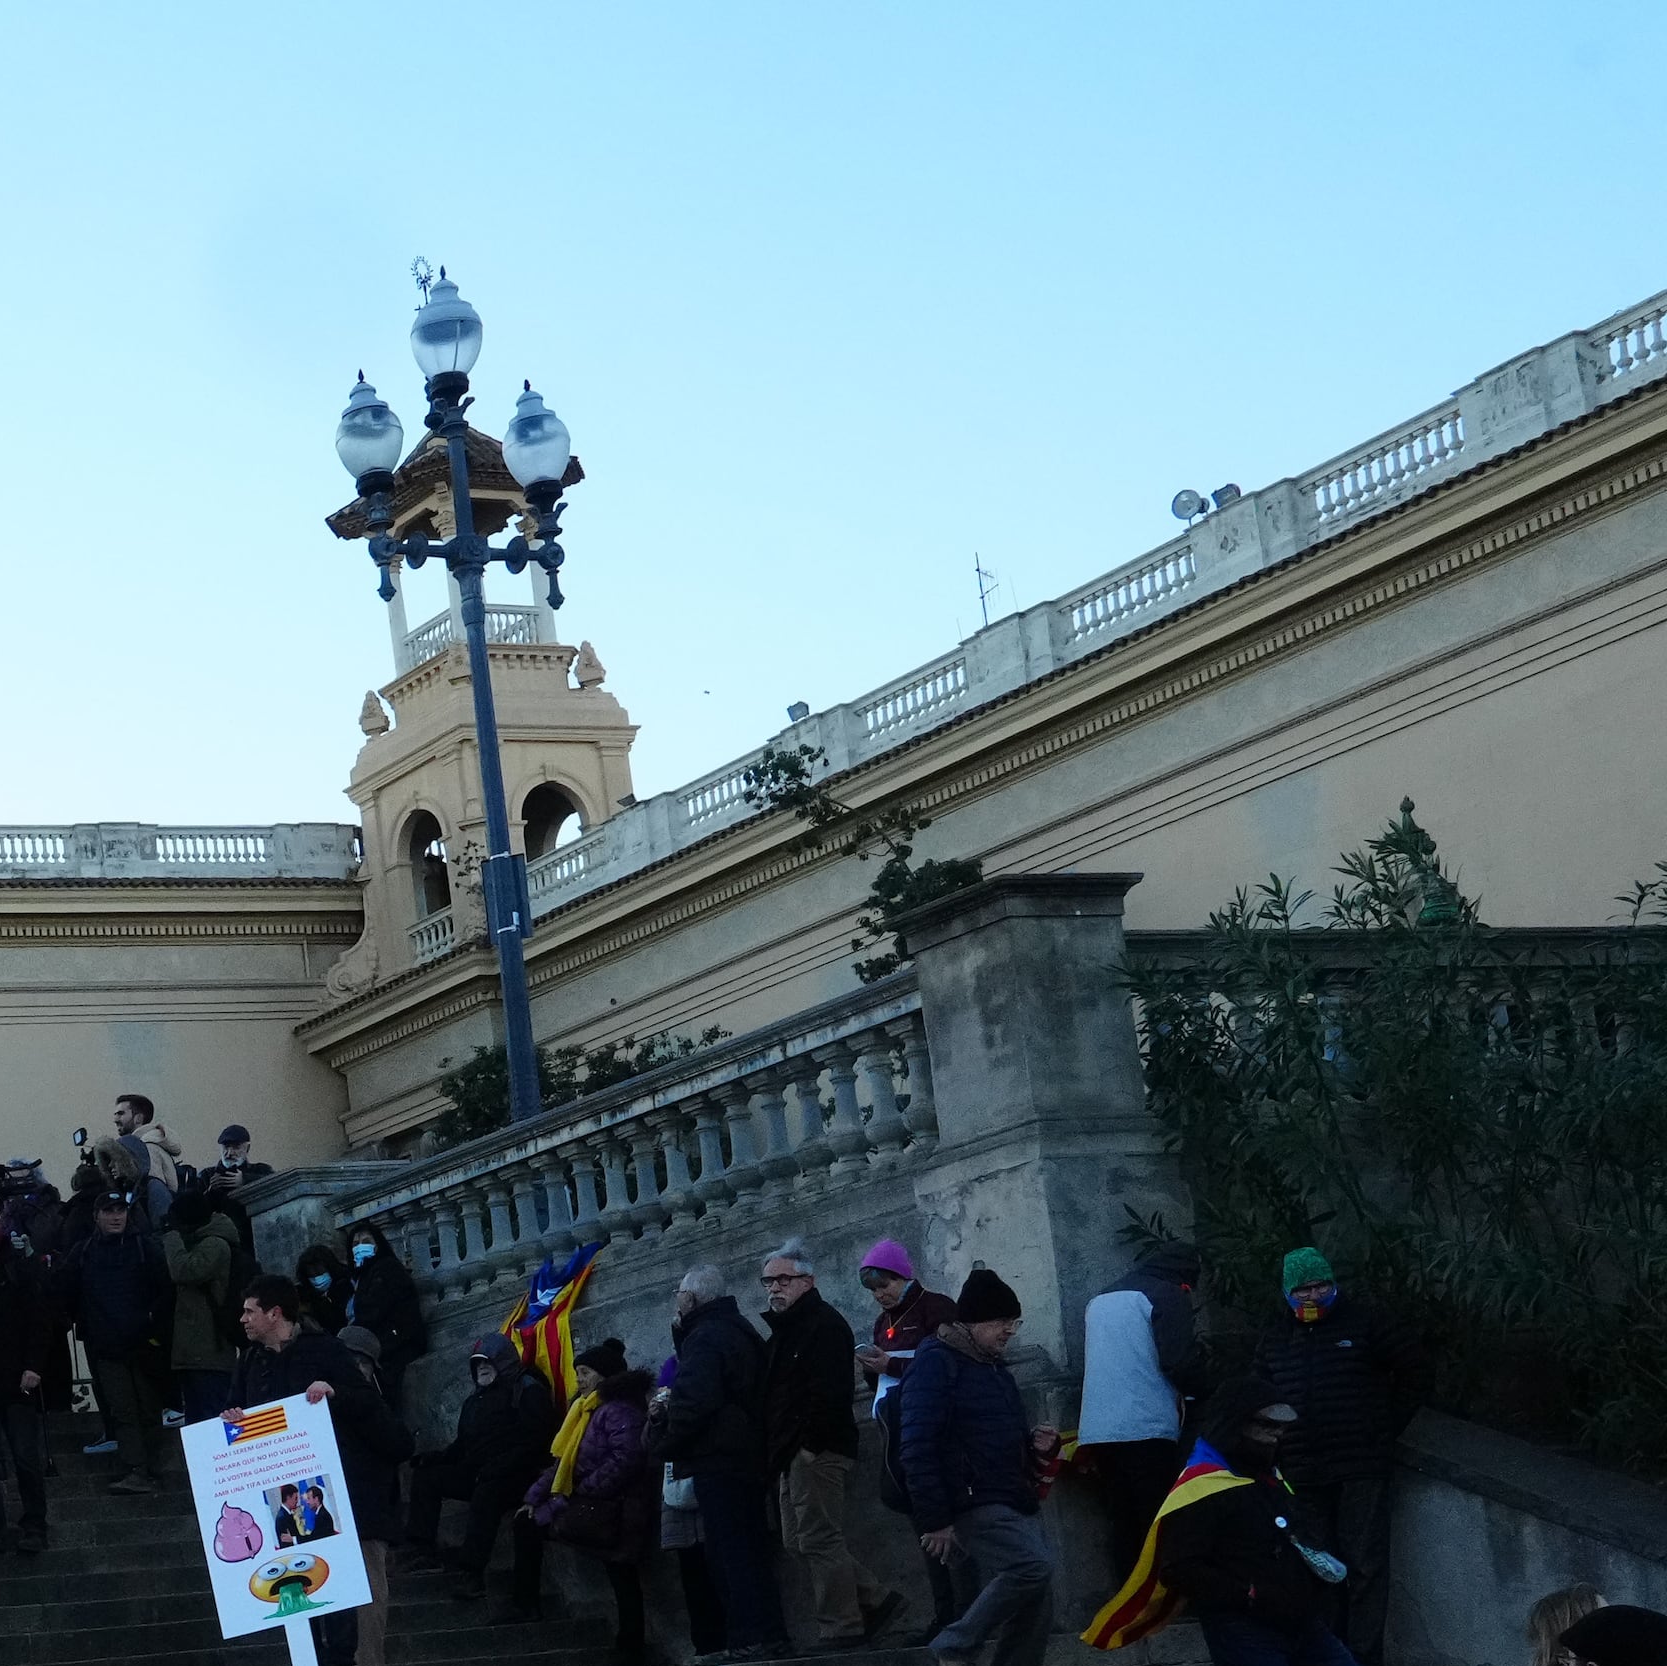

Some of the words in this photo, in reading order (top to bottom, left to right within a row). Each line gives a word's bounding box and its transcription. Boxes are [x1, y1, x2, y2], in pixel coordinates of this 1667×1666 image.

[213, 1453, 228, 1461] SOM
[255, 1440, 272, 1450] GENT
[273, 1431, 308, 1445] CATALANA
[257, 1454, 267, 1462] NO
[227, 1470, 253, 1482] VOSTRA
[231, 1485, 245, 1494] UNA
